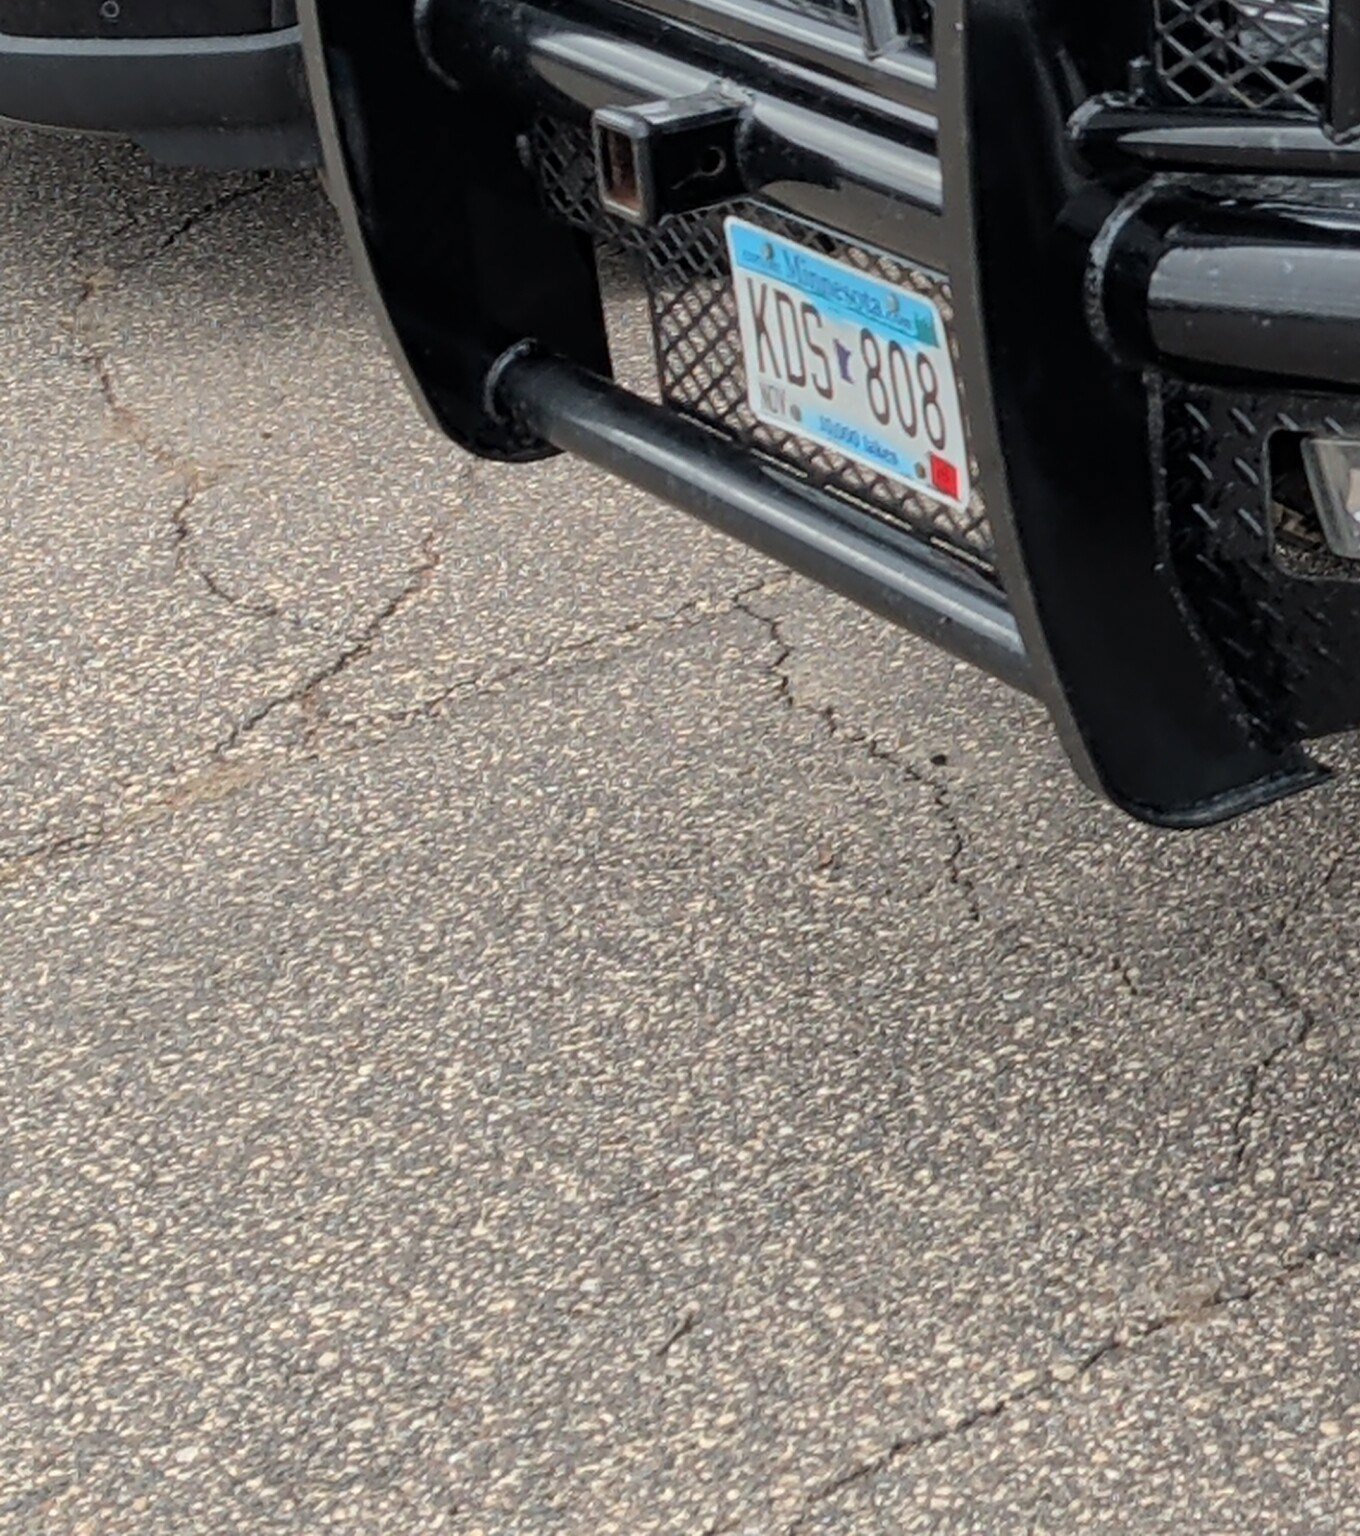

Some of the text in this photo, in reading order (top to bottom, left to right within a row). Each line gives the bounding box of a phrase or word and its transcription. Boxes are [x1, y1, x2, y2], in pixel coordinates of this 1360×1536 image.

[783, 249, 884, 315] Minnesota
[747, 277, 946, 451] KDS 808
